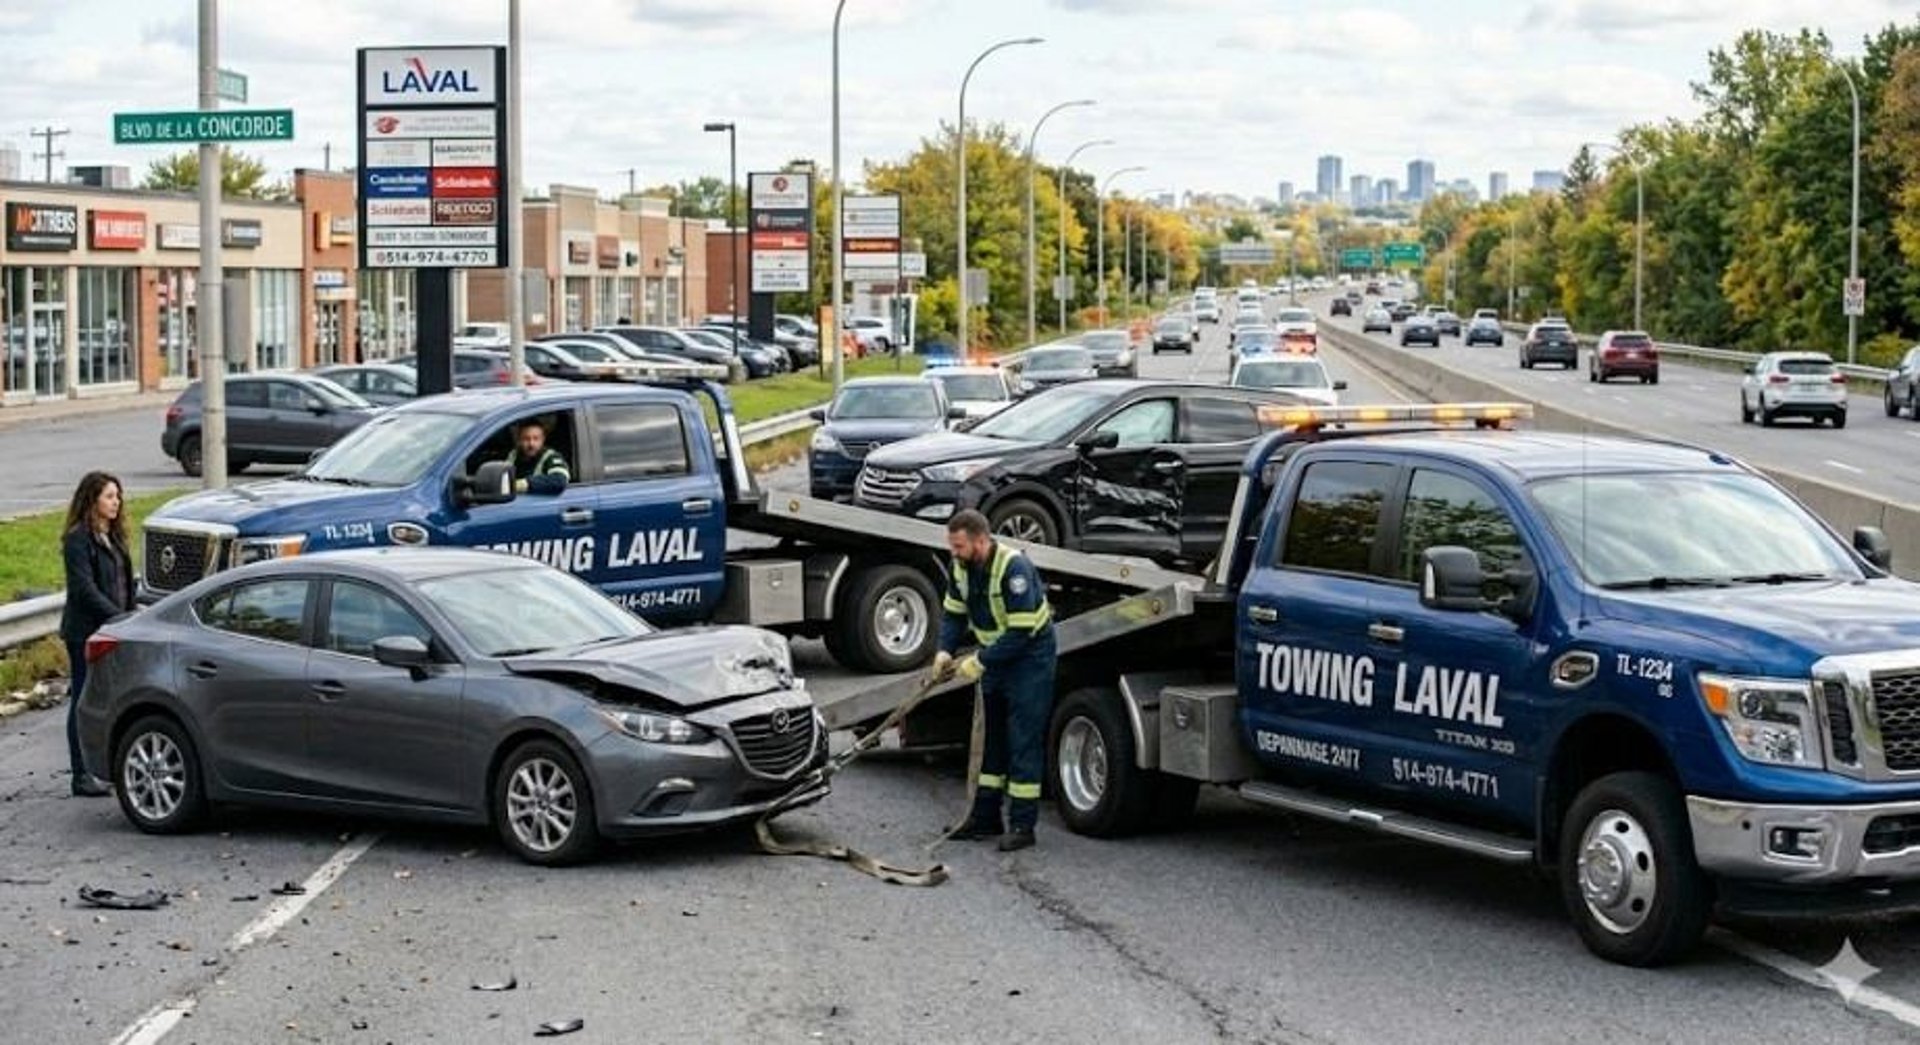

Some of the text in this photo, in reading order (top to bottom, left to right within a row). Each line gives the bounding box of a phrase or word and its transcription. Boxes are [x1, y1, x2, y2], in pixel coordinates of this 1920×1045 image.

[382, 57, 480, 93] LAVAL
[120, 116, 286, 139] BLVD DE LA CONCORDE
[473, 527, 703, 572] WING LAVAL
[1257, 642, 1505, 728] TOWING LAVAL
[1616, 653, 1673, 681] TL-1234
[1256, 729, 1330, 765] DEPANNAGE
